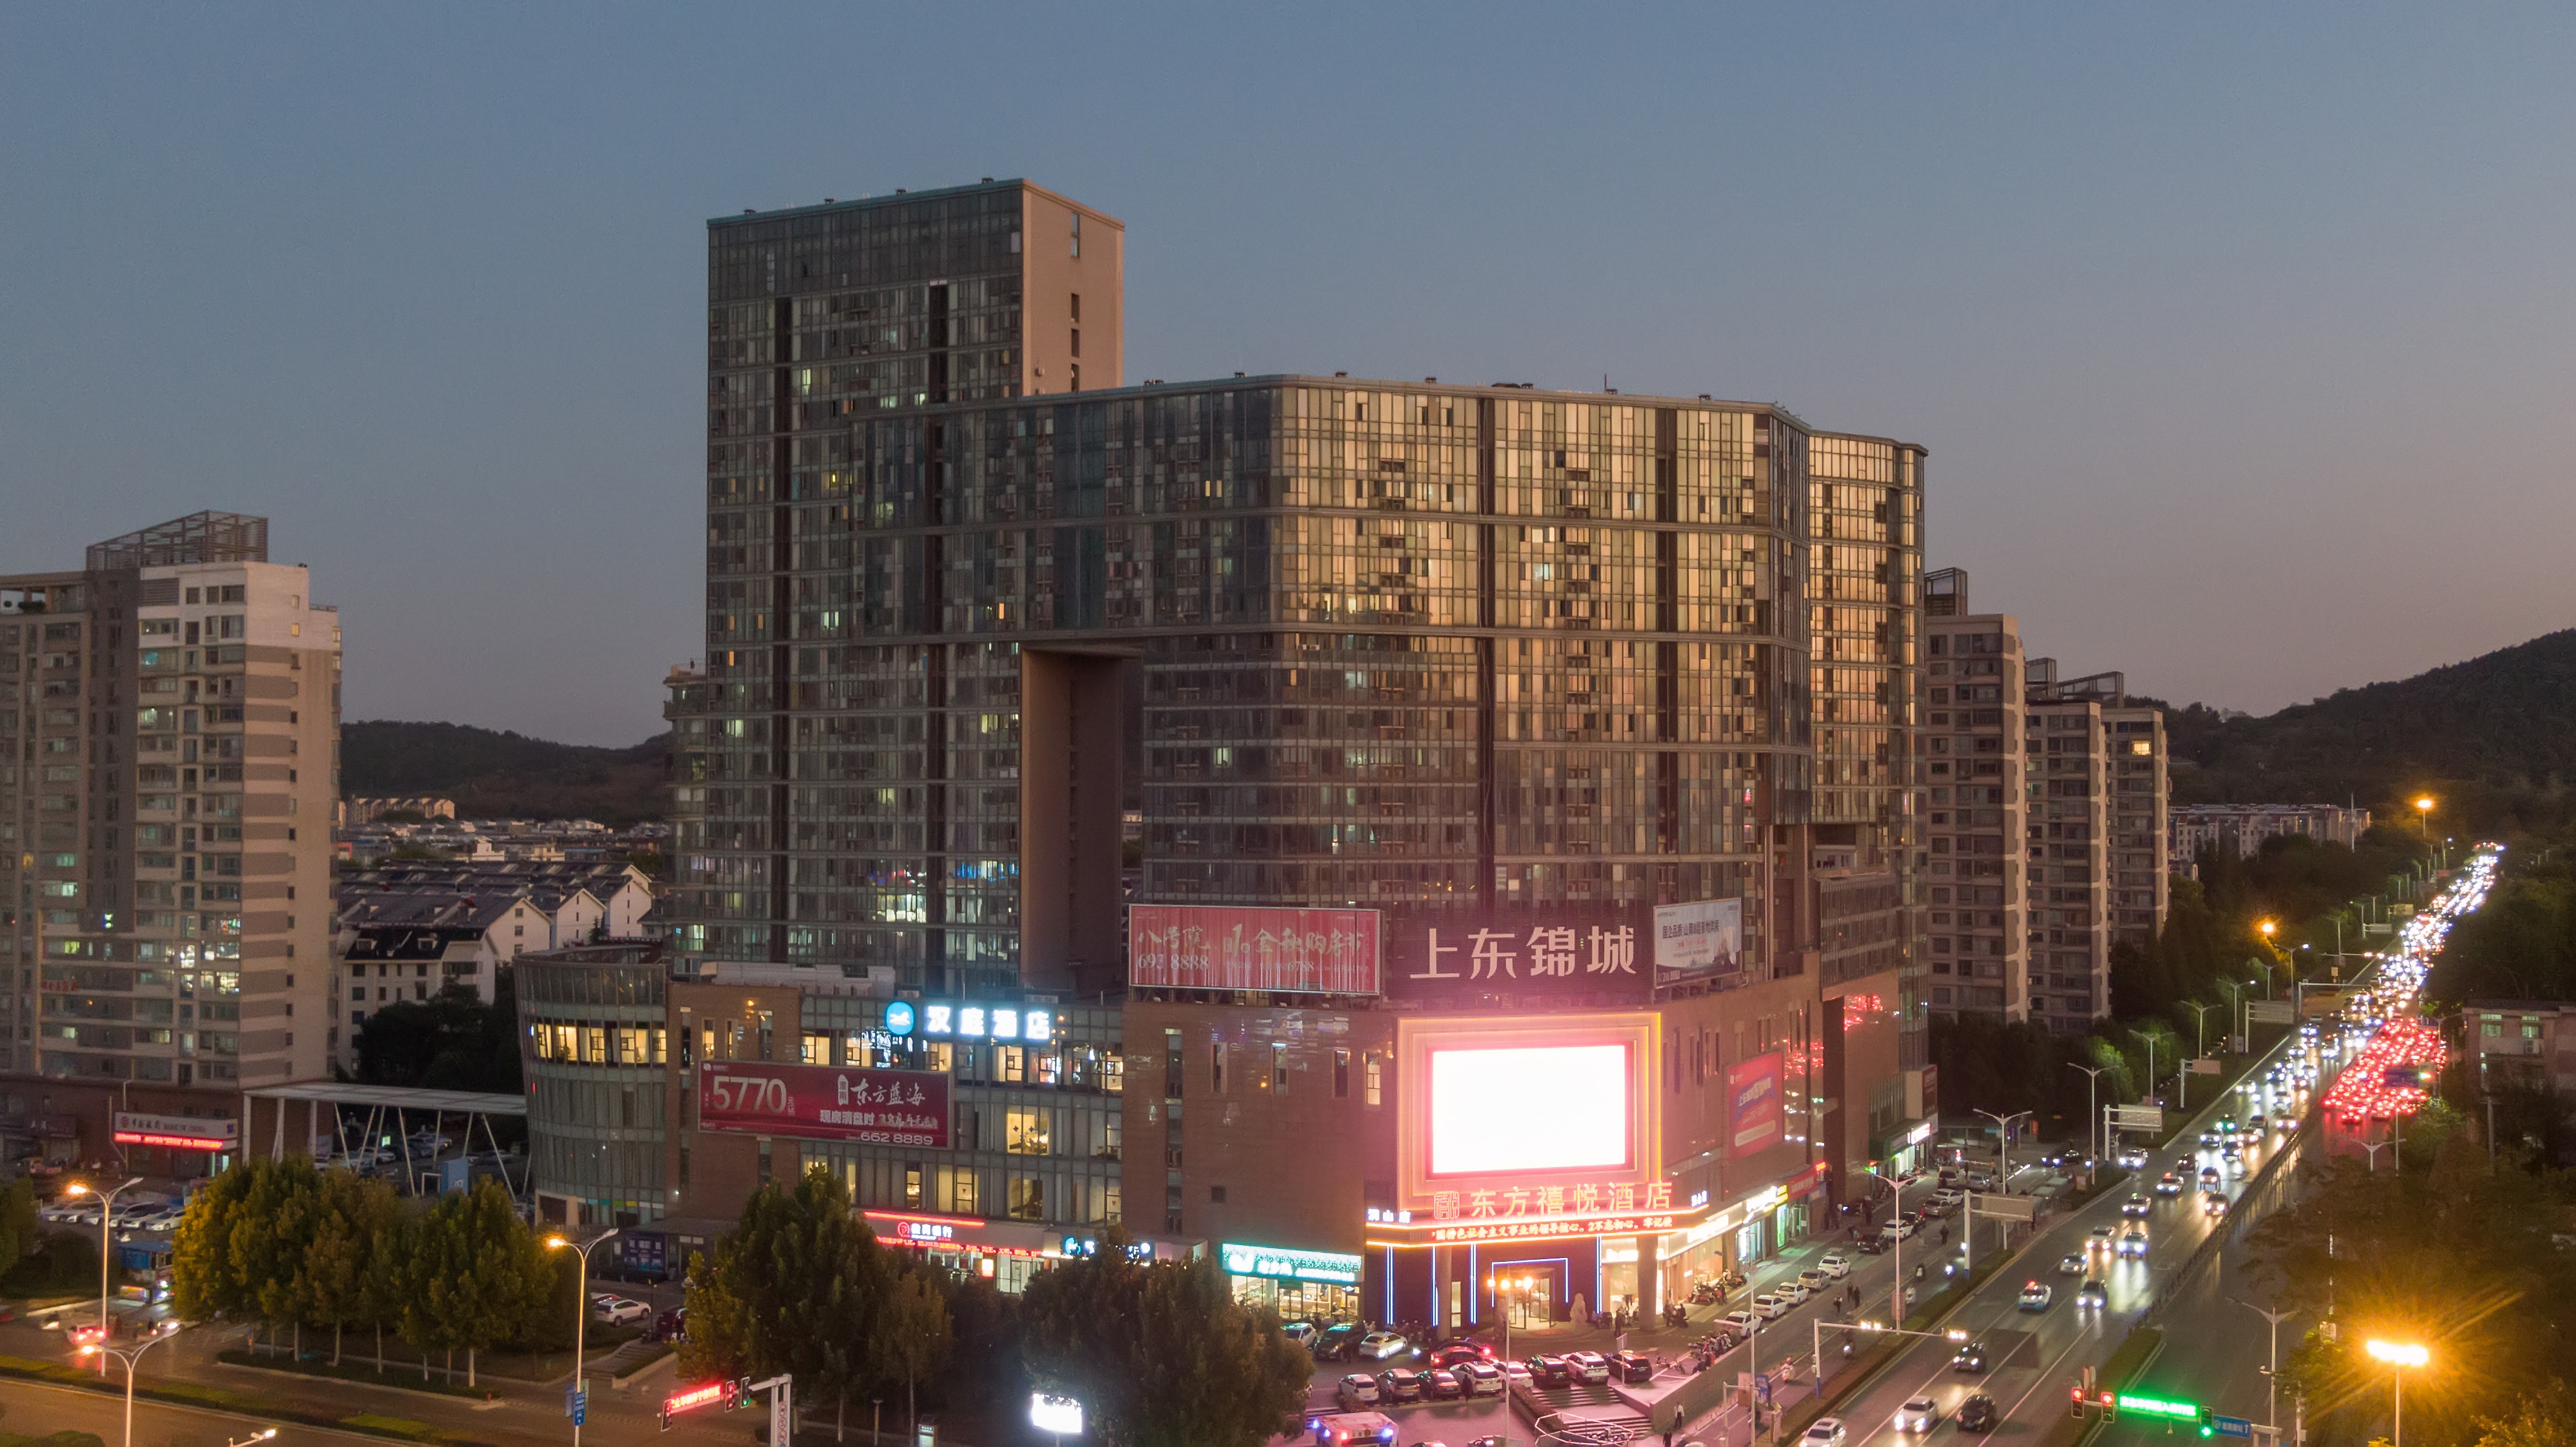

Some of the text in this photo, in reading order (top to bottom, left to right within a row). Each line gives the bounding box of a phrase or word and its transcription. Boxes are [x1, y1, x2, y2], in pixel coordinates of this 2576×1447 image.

[1138, 953, 1164, 969] 693
[1170, 953, 1209, 970] 8888
[1409, 925, 1636, 979] 上东锦城
[927, 1006, 1050, 1039] 汉庭酒店
[712, 1076, 787, 1113] 5770
[850, 1078, 926, 1106] 东方蓝海
[860, 1132, 890, 1143] 662
[893, 1133, 934, 1145] 8889
[1471, 1180, 1672, 1219] 东方禧悦酒店
